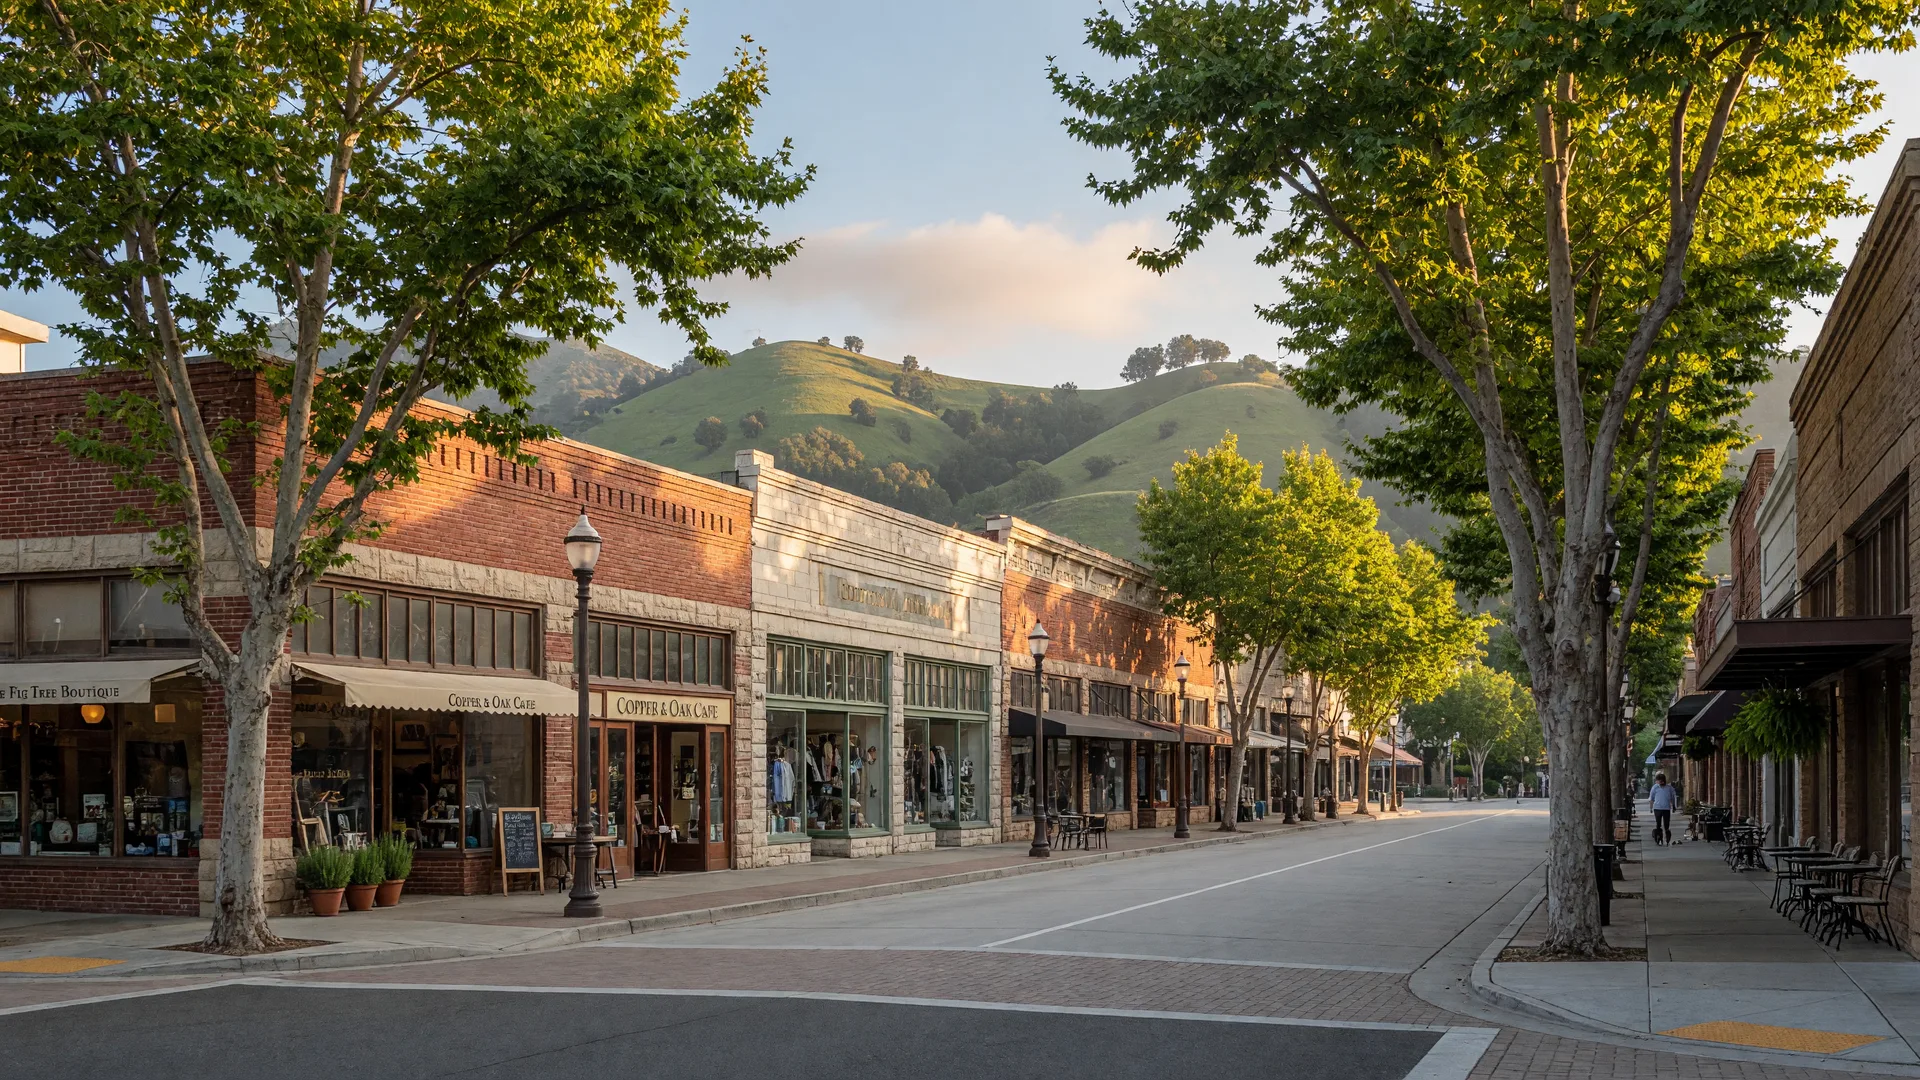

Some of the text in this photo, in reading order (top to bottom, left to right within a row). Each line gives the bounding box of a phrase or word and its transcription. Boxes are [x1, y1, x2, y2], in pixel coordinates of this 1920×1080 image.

[9, 686, 28, 699] FIG
[30, 685, 57, 698] TREE
[484, 697, 490, 708] &
[492, 695, 511, 709] OAK
[616, 696, 659, 716] COPPER
[660, 701, 668, 716] &
[669, 699, 693, 718] OAK
